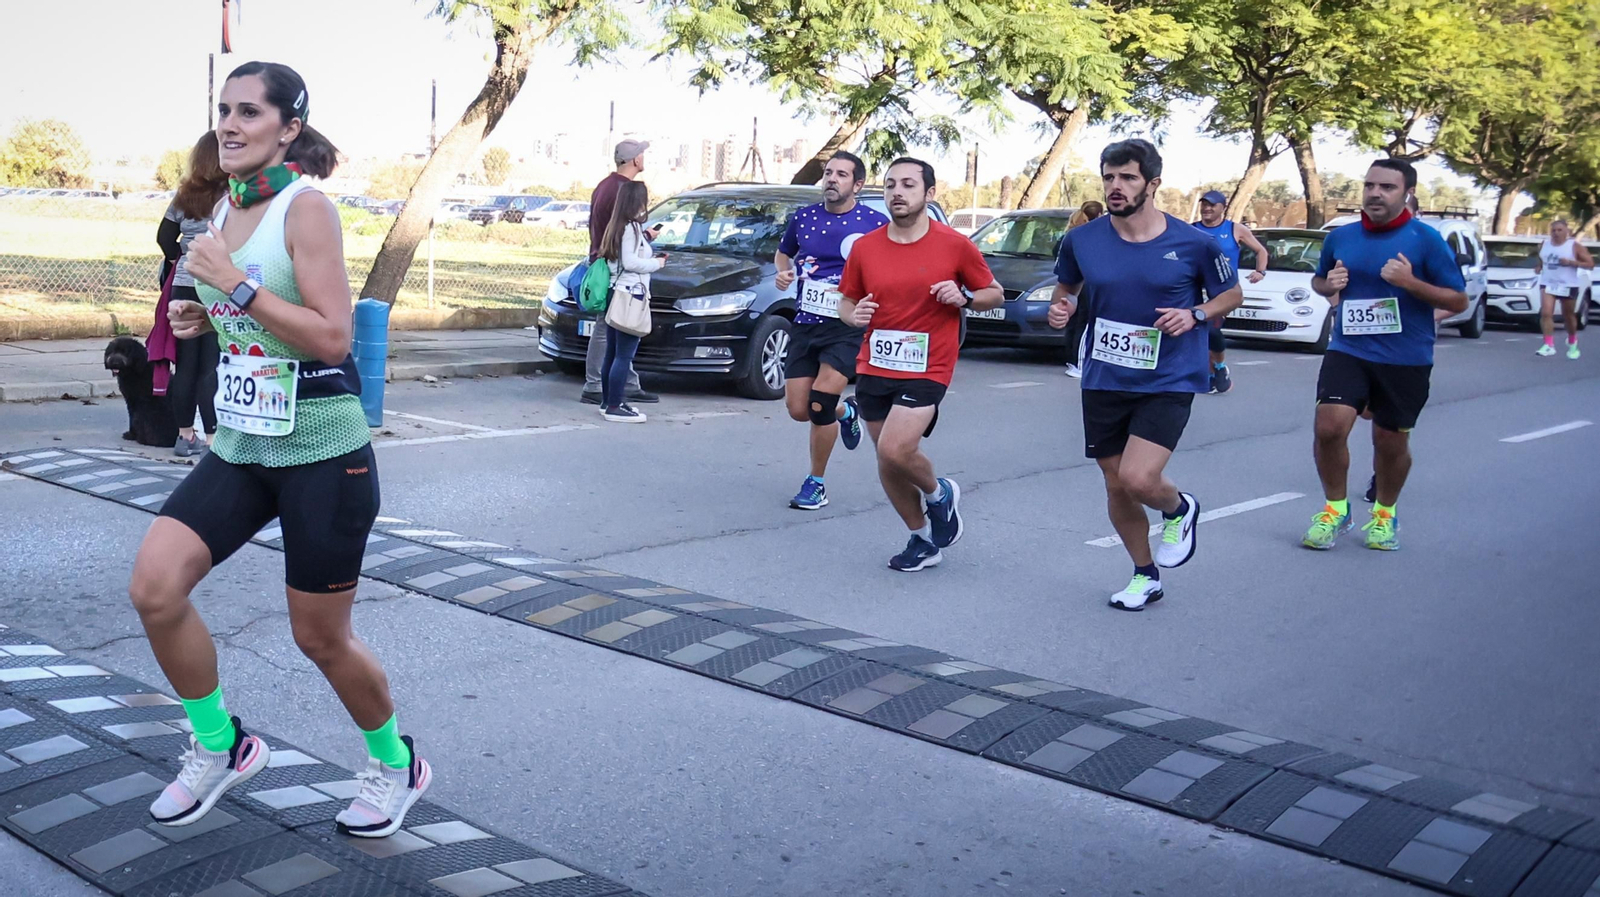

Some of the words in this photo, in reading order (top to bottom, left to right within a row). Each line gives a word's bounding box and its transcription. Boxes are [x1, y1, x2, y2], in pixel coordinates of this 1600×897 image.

[806, 289, 825, 304] 531
[1239, 310, 1257, 318] LSX
[1347, 308, 1375, 323] 335
[223, 321, 266, 333] ERE
[875, 340, 903, 357] 597
[1100, 331, 1130, 352] 453
[224, 374, 256, 406] 329
